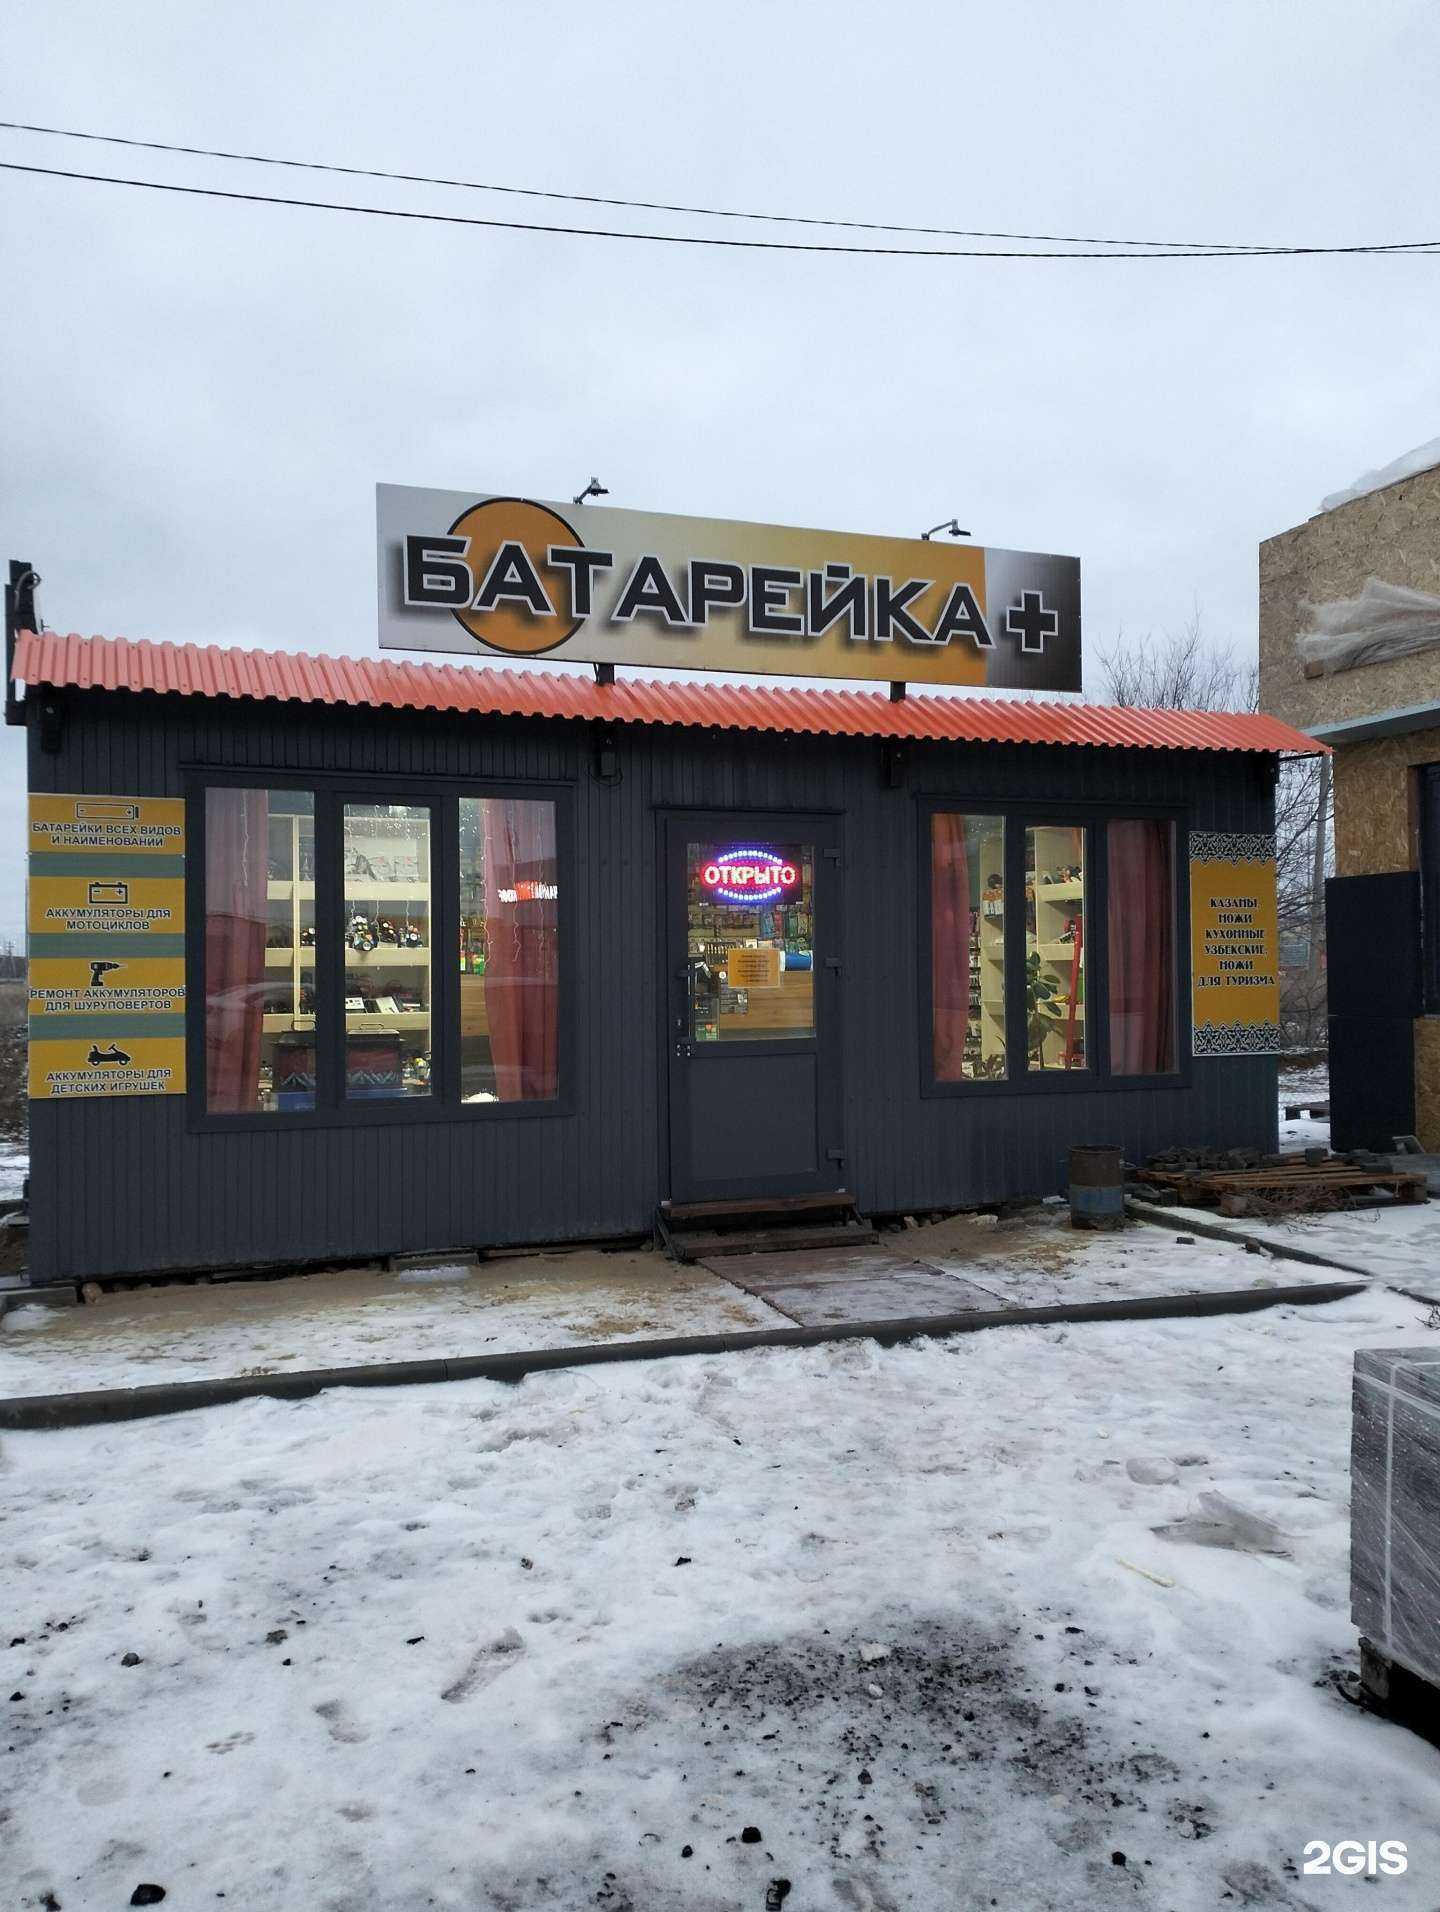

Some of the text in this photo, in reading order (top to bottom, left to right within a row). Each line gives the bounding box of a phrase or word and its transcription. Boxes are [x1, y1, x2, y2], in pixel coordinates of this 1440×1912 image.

[402, 531, 996, 650] БАТАРЕЙКА
[32, 821, 181, 836] БАТАРЕЙКИ ВСЕХ ВИДОВ
[51, 836, 60, 844] И
[703, 865, 796, 885] ОТКРЫТО
[46, 908, 171, 919] АККУМУЛЯТОРЫ ДЛЯ
[1218, 914, 1252, 923] НОЖИ
[66, 920, 150, 930] МОТОЦИКЛОВ
[1206, 929, 1265, 939] КУХОННЫЕ
[1219, 960, 1253, 970] НОЖИ
[1198, 975, 1275, 987] ДЛЯ ТУРИЗМА
[30, 988, 185, 998] РЕМОНТ АККУМУЛЯТОРОВ
[45, 1000, 171, 1011] ДЛЯ ШУРУПОВЕРТОВ
[46, 1069, 171, 1081] АККУМУЛЯТОРЫ ДЛЯ
[51, 1081, 165, 1094] ДЕТСКИХ ИГРУШЕК
